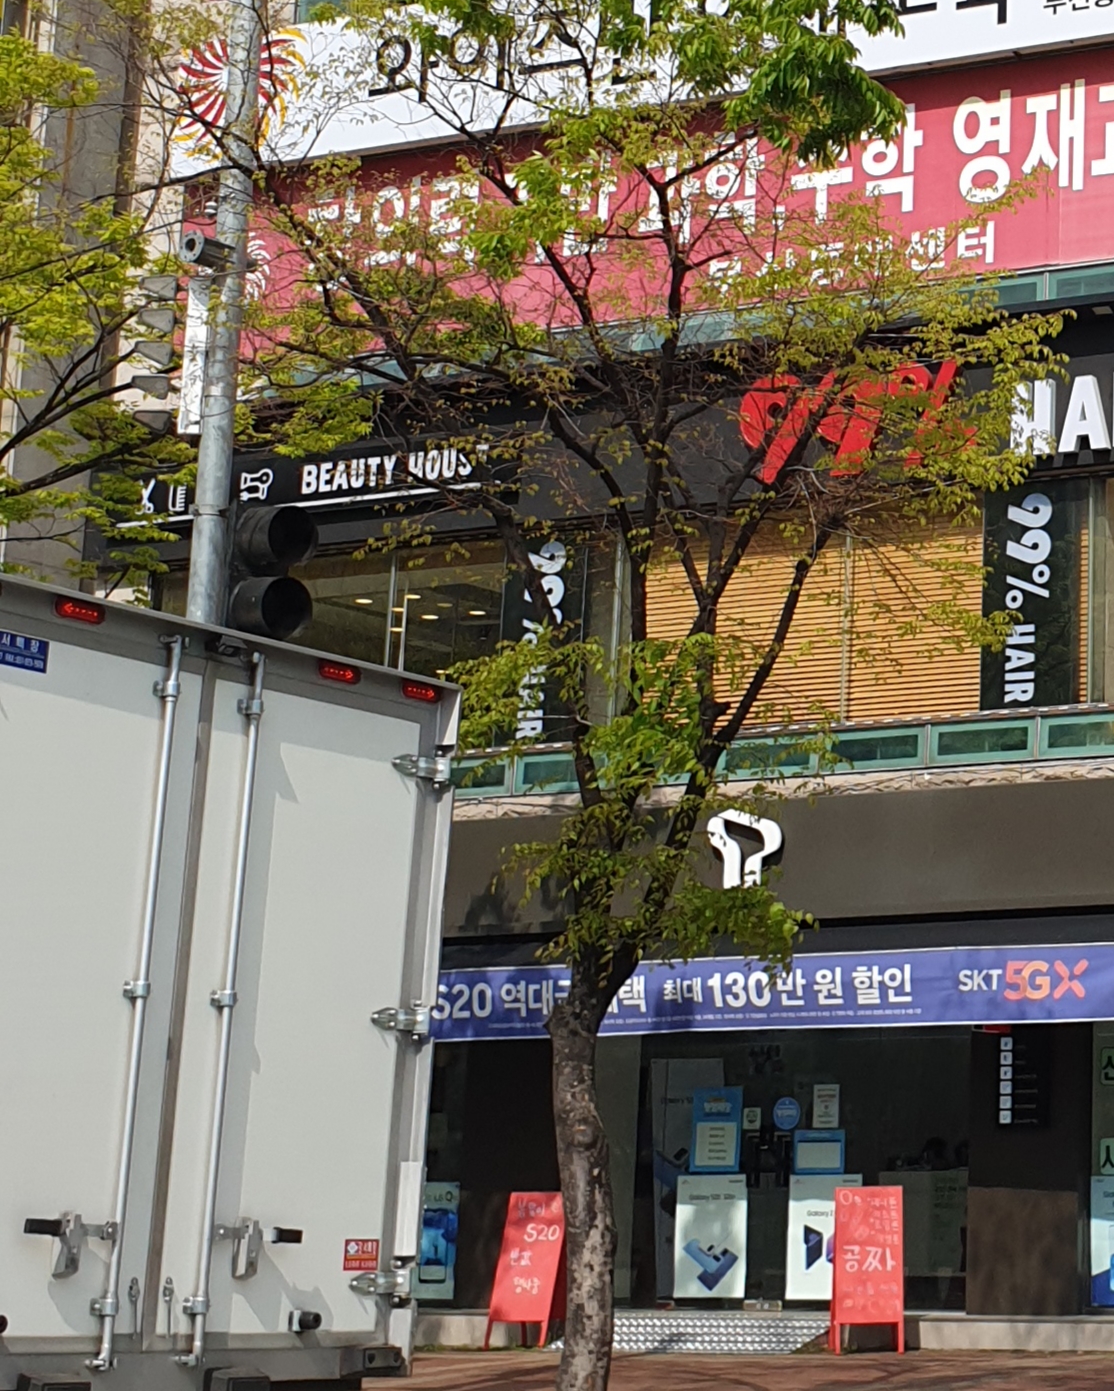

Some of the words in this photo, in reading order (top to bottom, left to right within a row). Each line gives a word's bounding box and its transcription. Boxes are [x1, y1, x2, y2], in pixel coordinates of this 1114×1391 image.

[301, 455, 398, 496] BEAUTY
[1004, 492, 1054, 610] 99%
[1003, 622, 1036, 705] HAIR
[431, 982, 492, 1021] S20
[663, 976, 703, 1004] 최대
[852, 963, 913, 1006] 할인
[958, 969, 1002, 992] SKT
[1004, 959, 1089, 1000] 5GX
[523, 1223, 560, 1242] S20
[842, 1244, 897, 1273] 공짜
